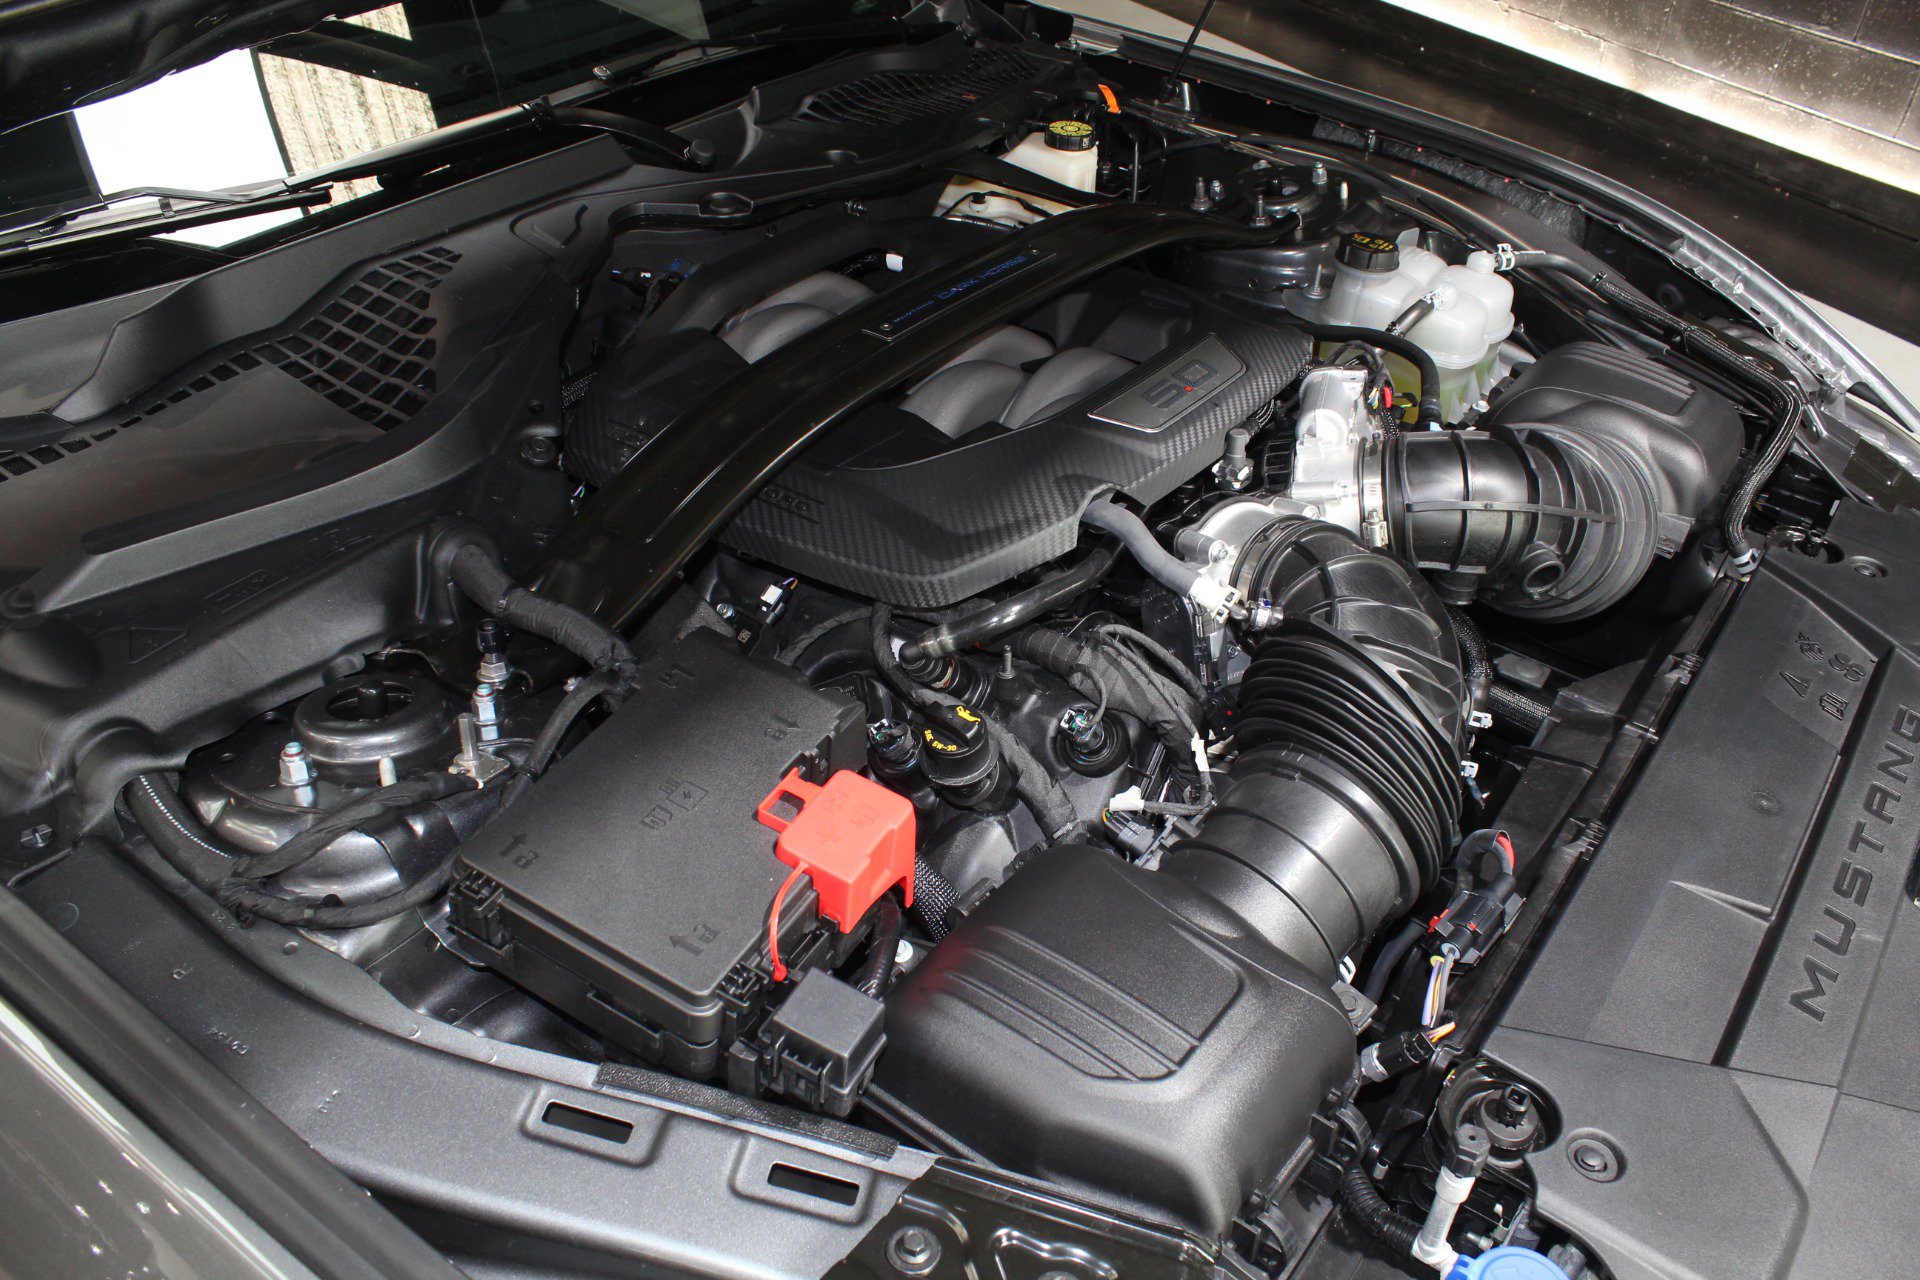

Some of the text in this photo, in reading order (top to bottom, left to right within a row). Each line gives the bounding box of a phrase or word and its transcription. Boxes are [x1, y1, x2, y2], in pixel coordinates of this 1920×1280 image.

[937, 278, 980, 301] DARK
[979, 255, 1029, 280] HORSE
[1140, 359, 1218, 409] 5.0
[924, 729, 958, 752] SAE 5W-30
[1788, 705, 1920, 1022] MUSTANG
